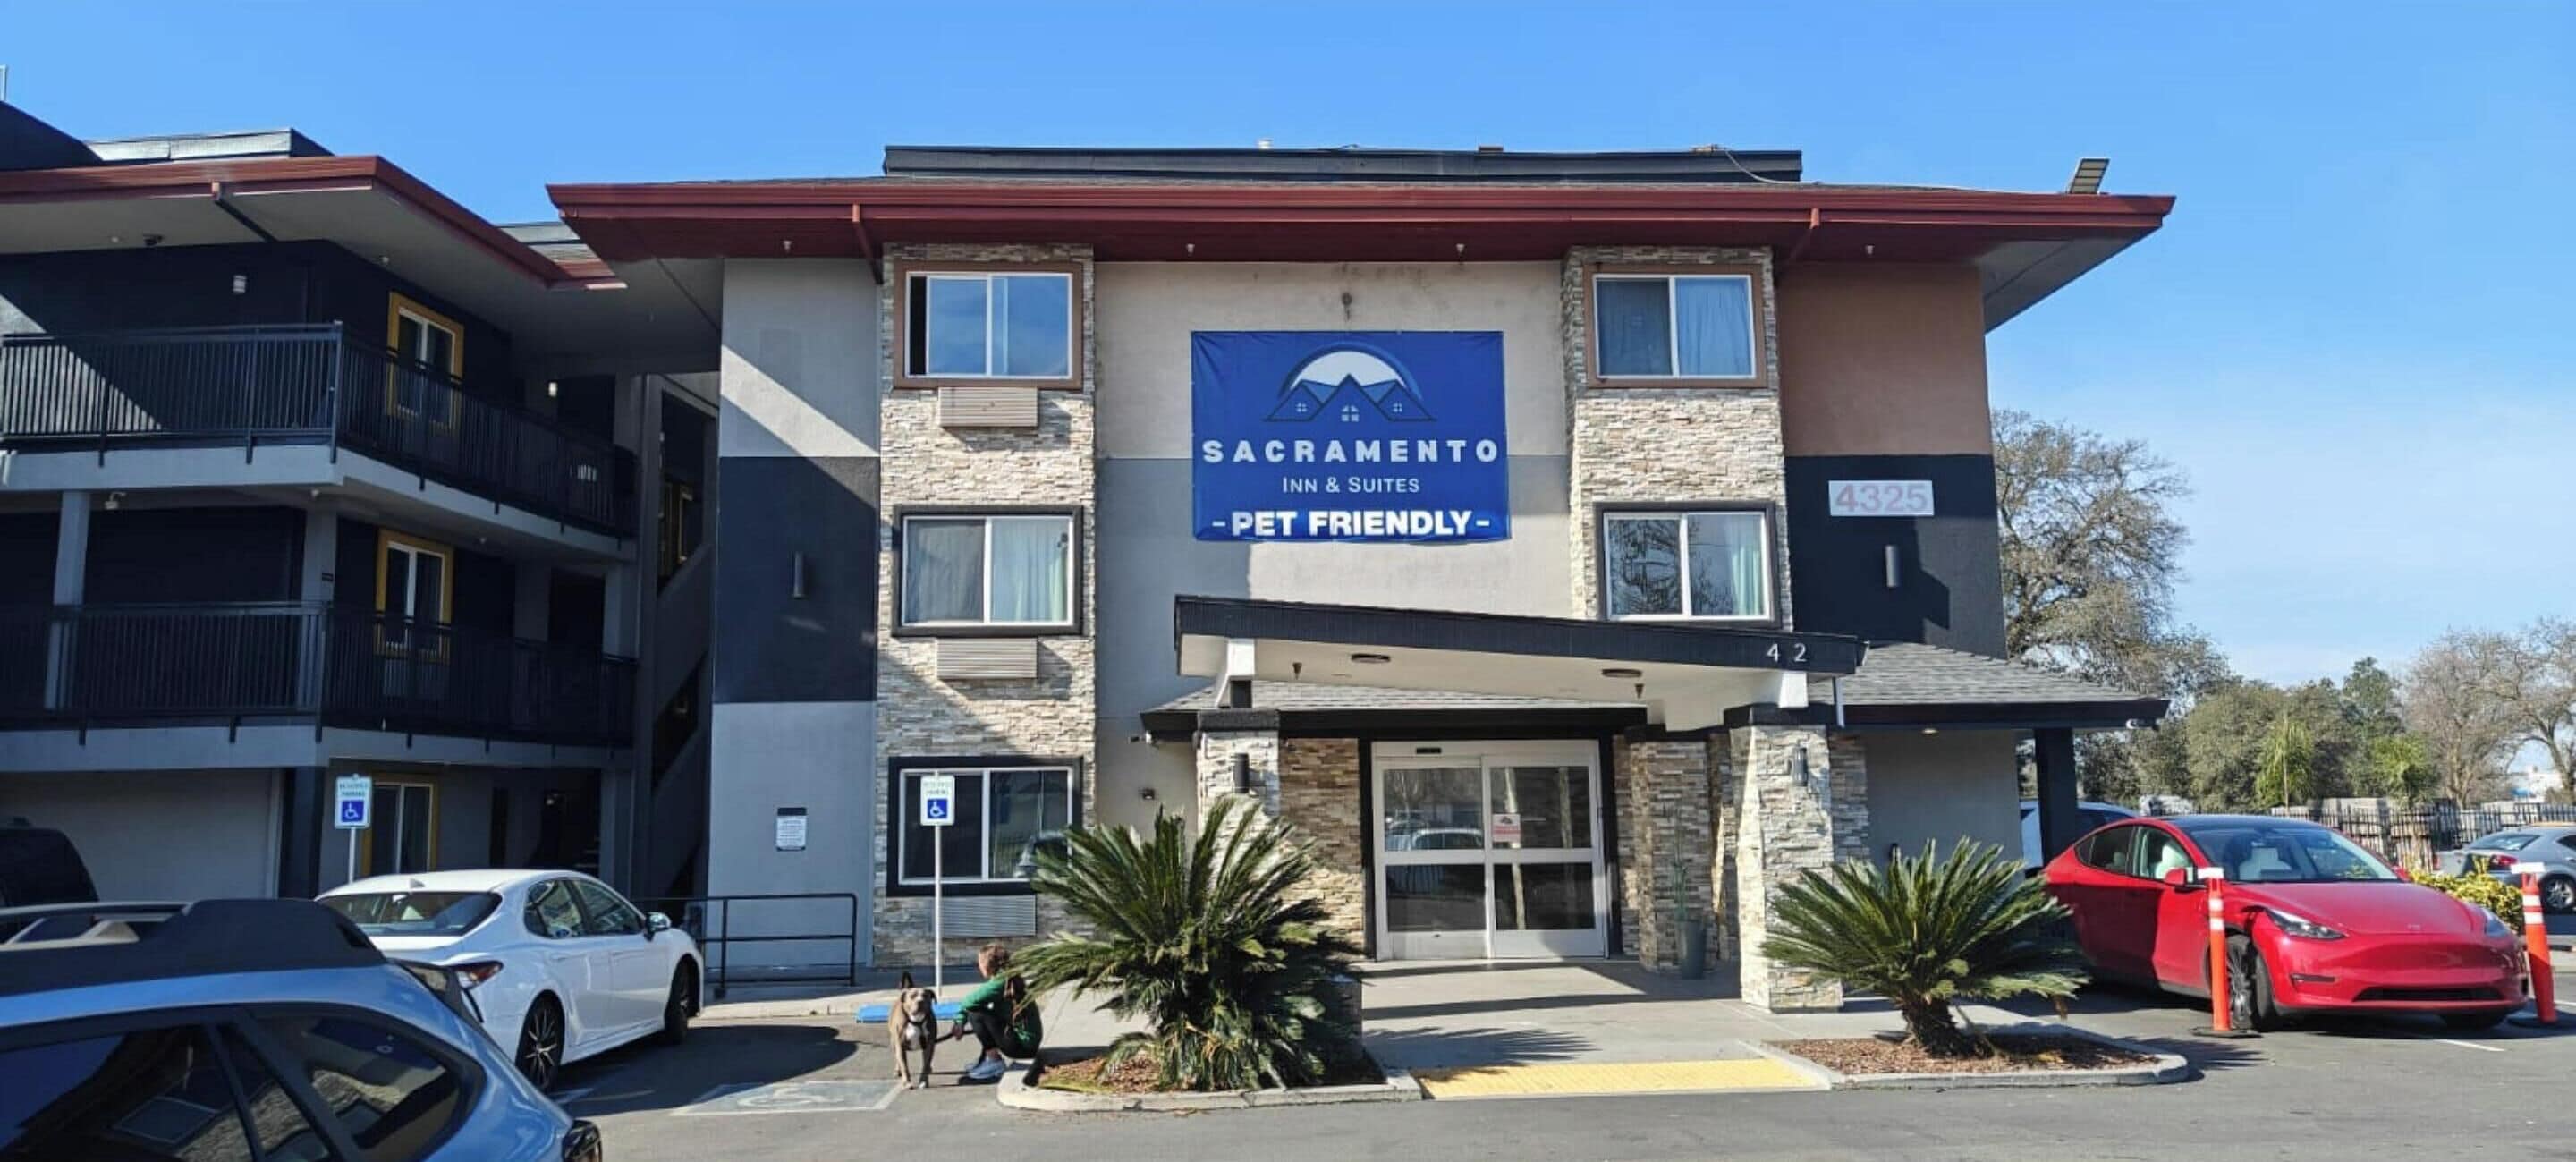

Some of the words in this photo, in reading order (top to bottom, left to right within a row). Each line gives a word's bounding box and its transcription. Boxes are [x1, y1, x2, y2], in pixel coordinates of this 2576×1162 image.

[1202, 439, 1497, 462] SACRAMENTO
[1326, 477, 1340, 493] &
[1835, 484, 1928, 512] 4325
